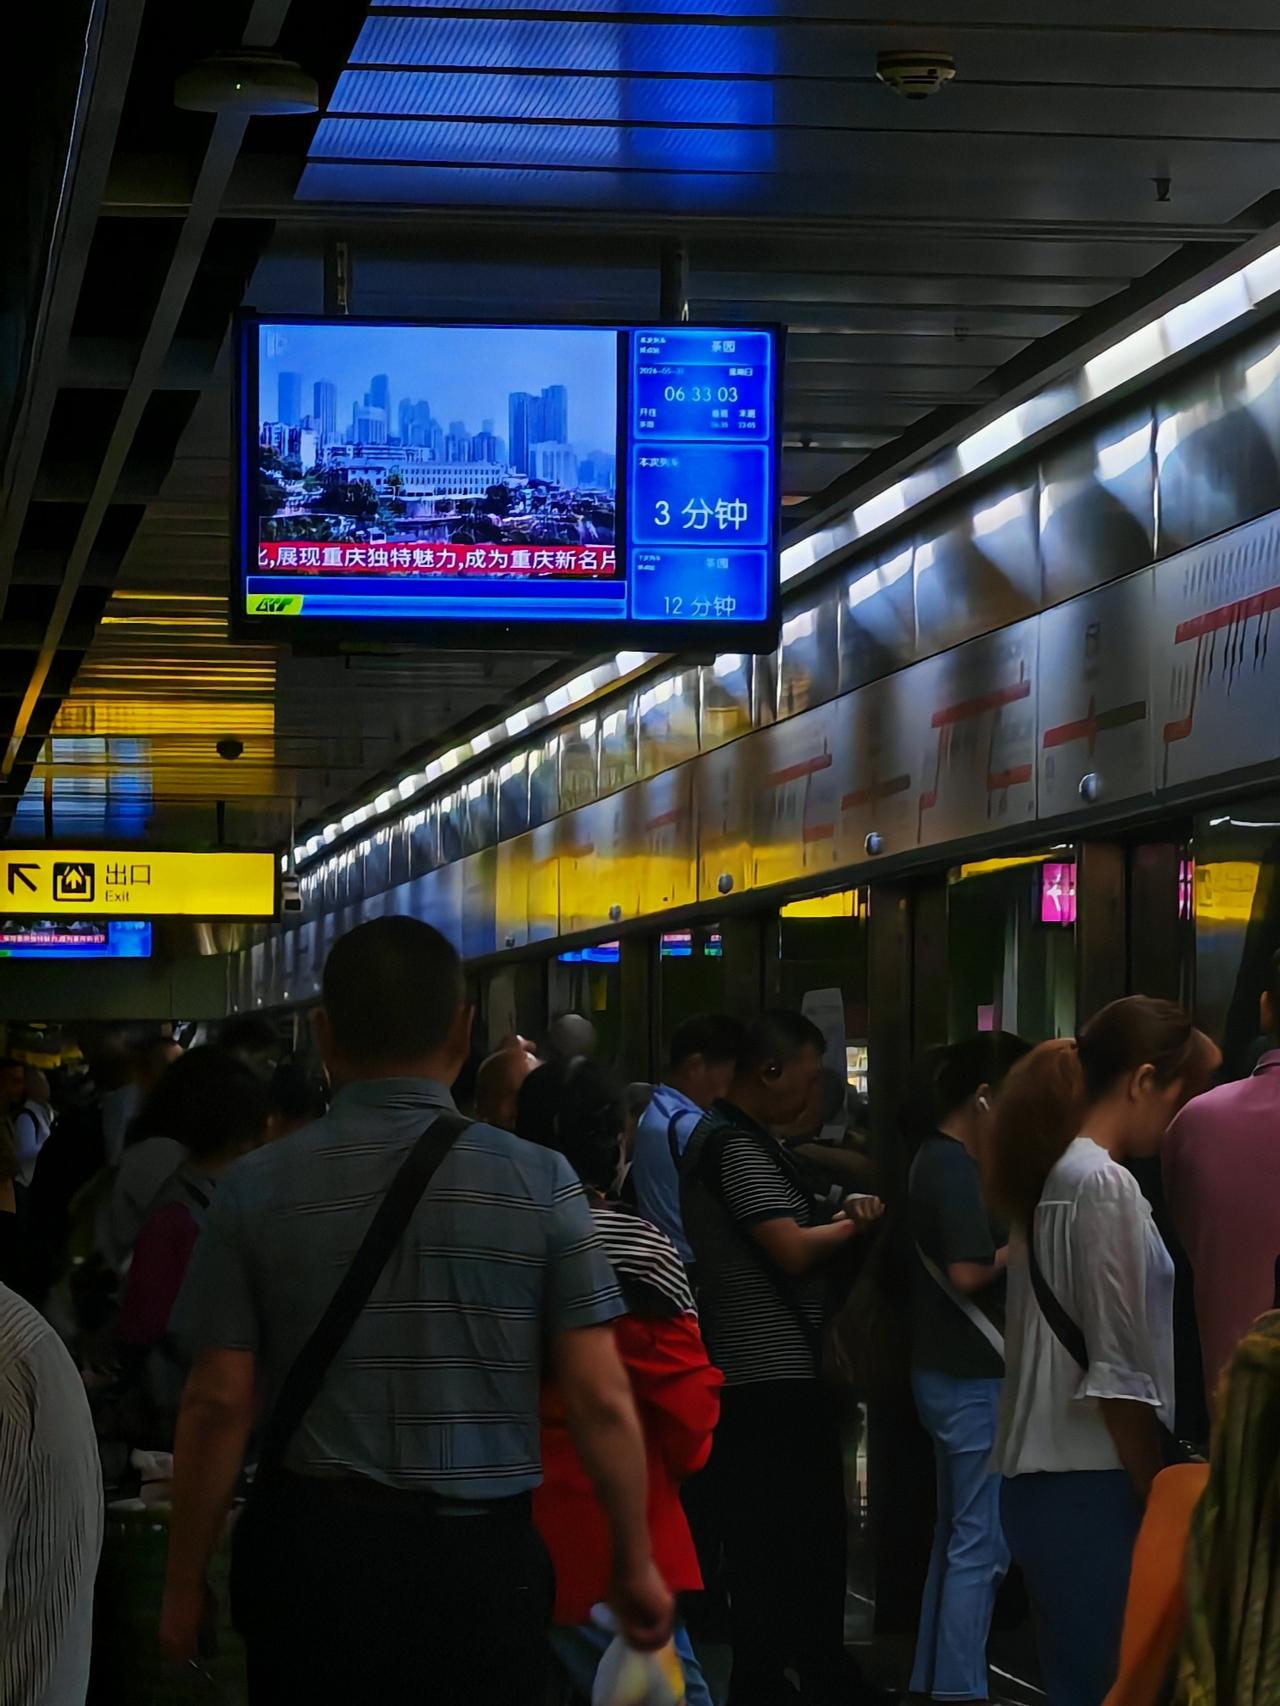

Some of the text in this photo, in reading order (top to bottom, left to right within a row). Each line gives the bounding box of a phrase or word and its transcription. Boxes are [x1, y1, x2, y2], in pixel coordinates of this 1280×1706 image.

[664, 386, 738, 403] 06 33 03
[654, 497, 748, 530] 3 分钟
[664, 594, 737, 617] 12 分钟
[105, 862, 151, 886] 出口
[105, 890, 130, 902] Exit
